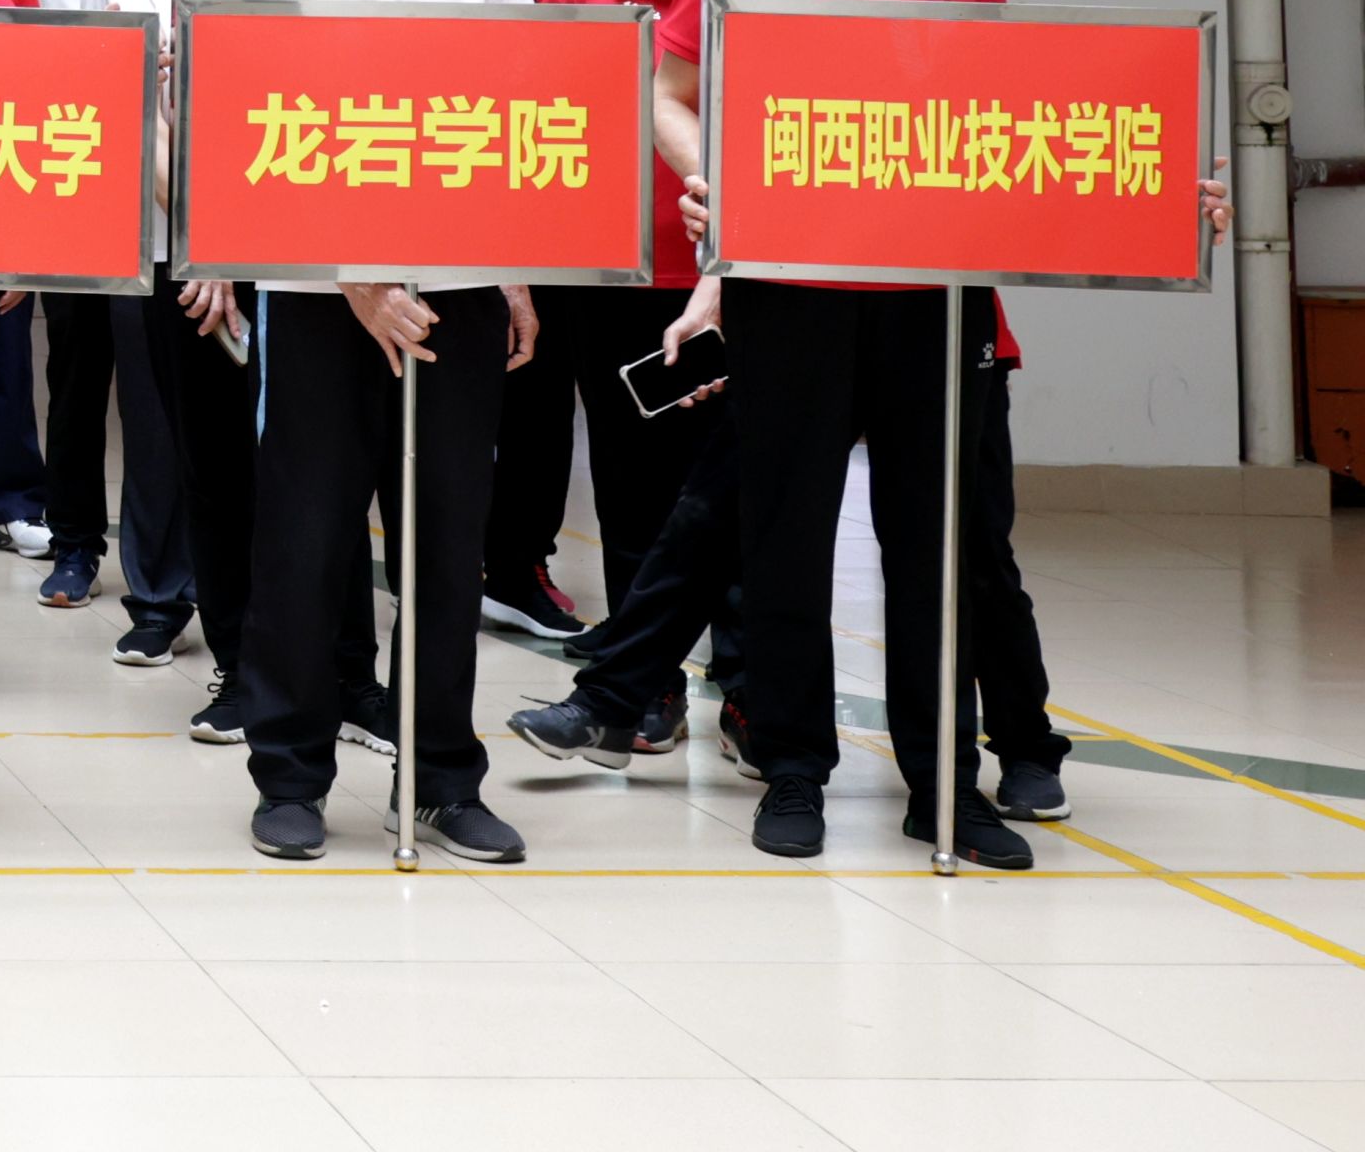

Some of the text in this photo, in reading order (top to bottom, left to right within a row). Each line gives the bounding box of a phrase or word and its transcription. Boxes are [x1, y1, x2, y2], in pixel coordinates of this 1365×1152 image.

[245, 93, 589, 189] 龙岩学院
[764, 97, 1162, 195] 闽西职业技术学院
